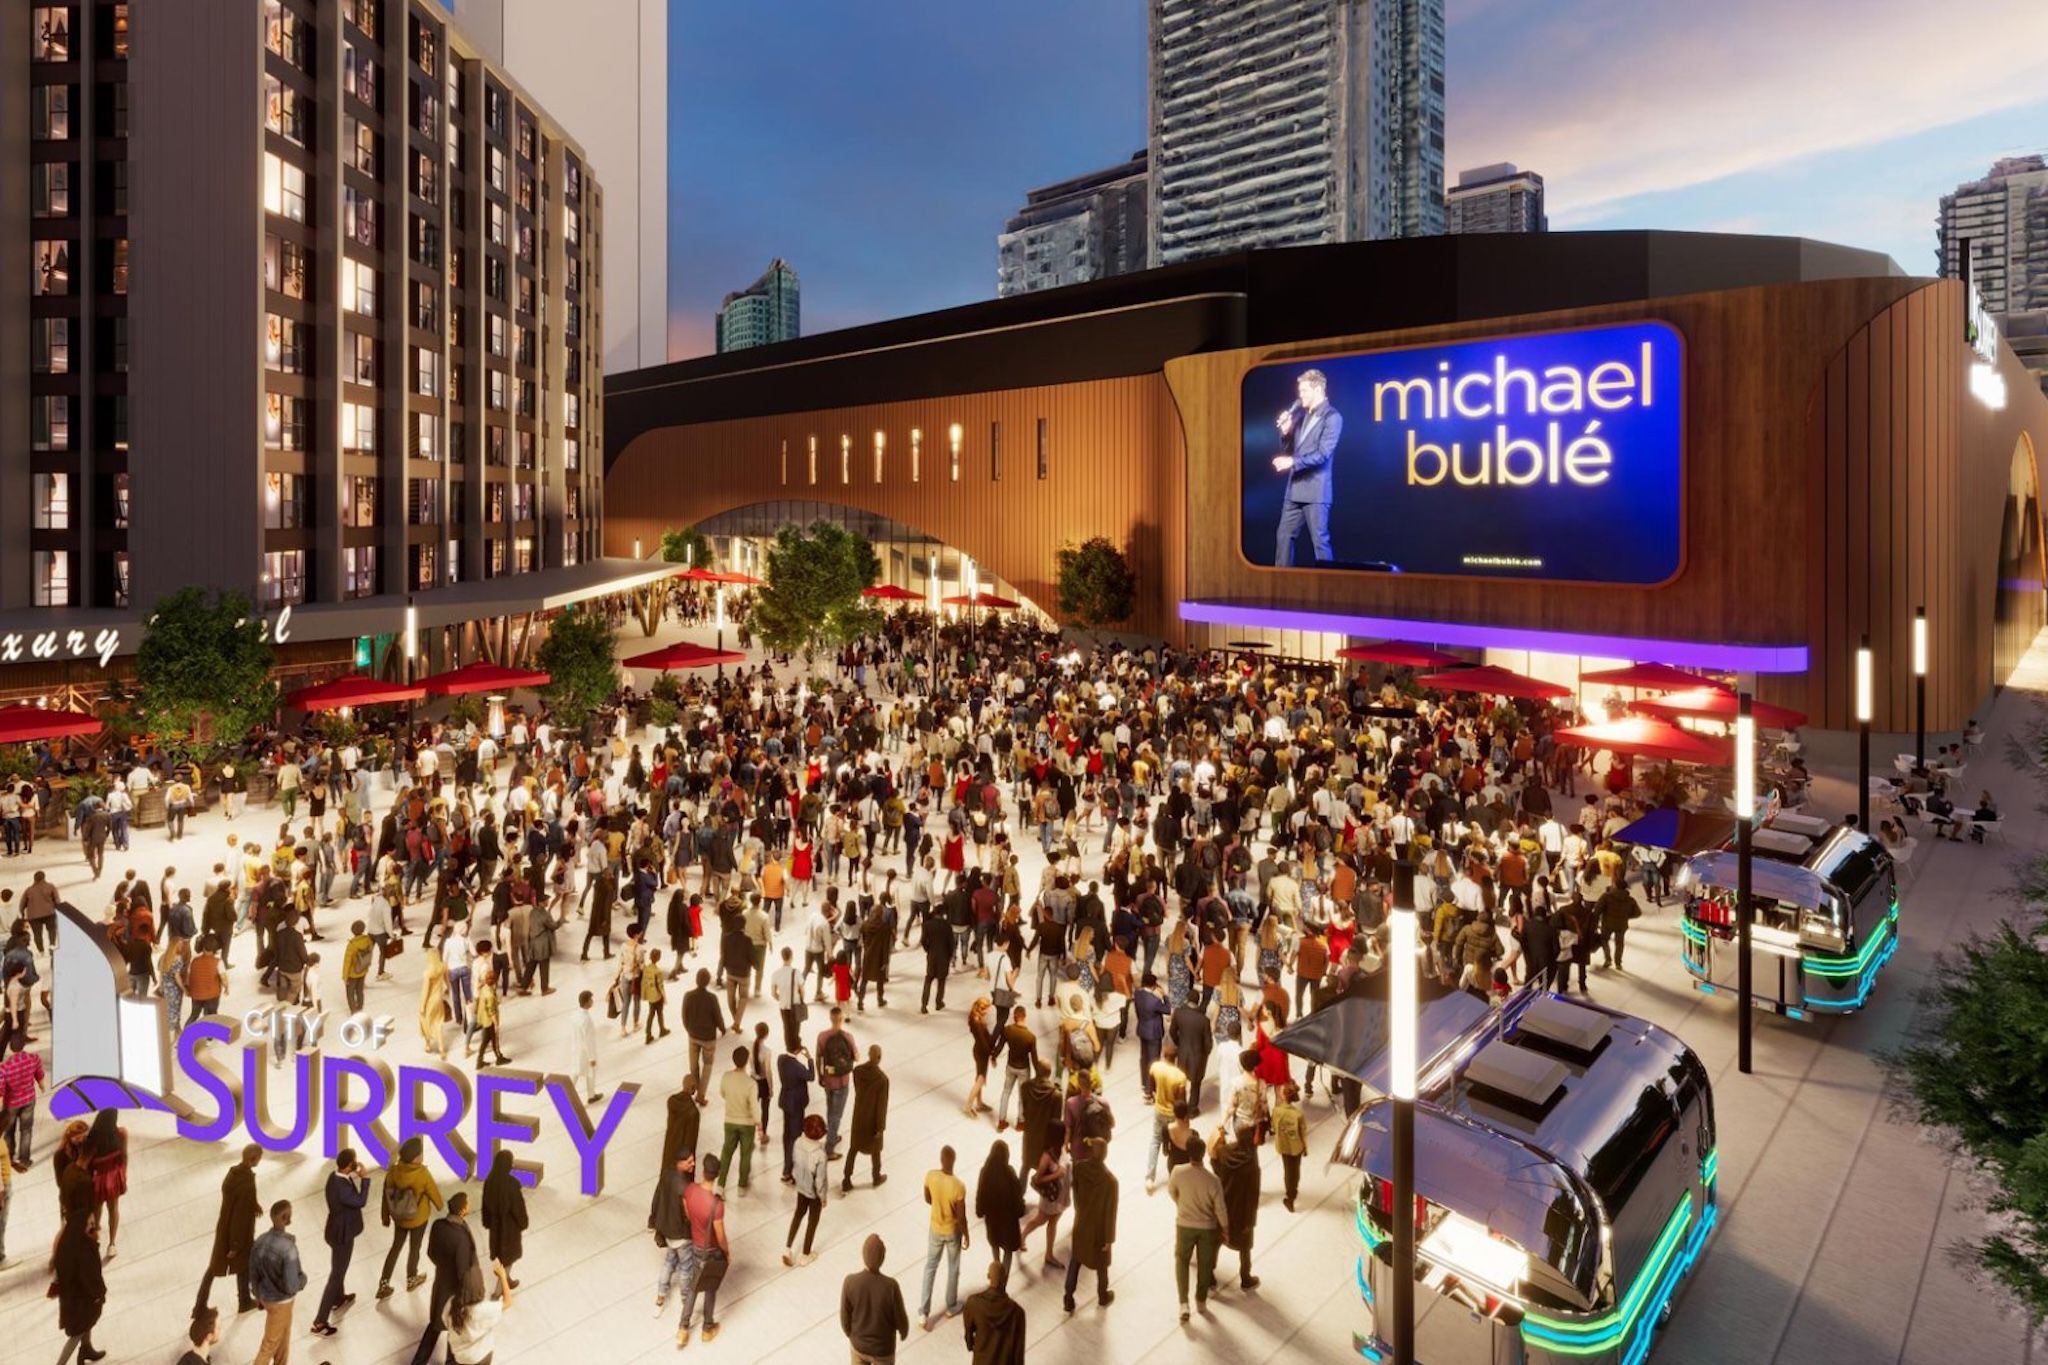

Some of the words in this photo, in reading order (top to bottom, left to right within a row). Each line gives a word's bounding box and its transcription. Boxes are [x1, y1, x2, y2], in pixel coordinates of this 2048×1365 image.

[1373, 341, 1653, 423] michael
[1406, 419, 1613, 486] bublé
[1, 628, 120, 668] xury
[244, 1008, 325, 1043] CITY
[339, 1016, 389, 1050] OF
[176, 1017, 639, 1197] SURREY
